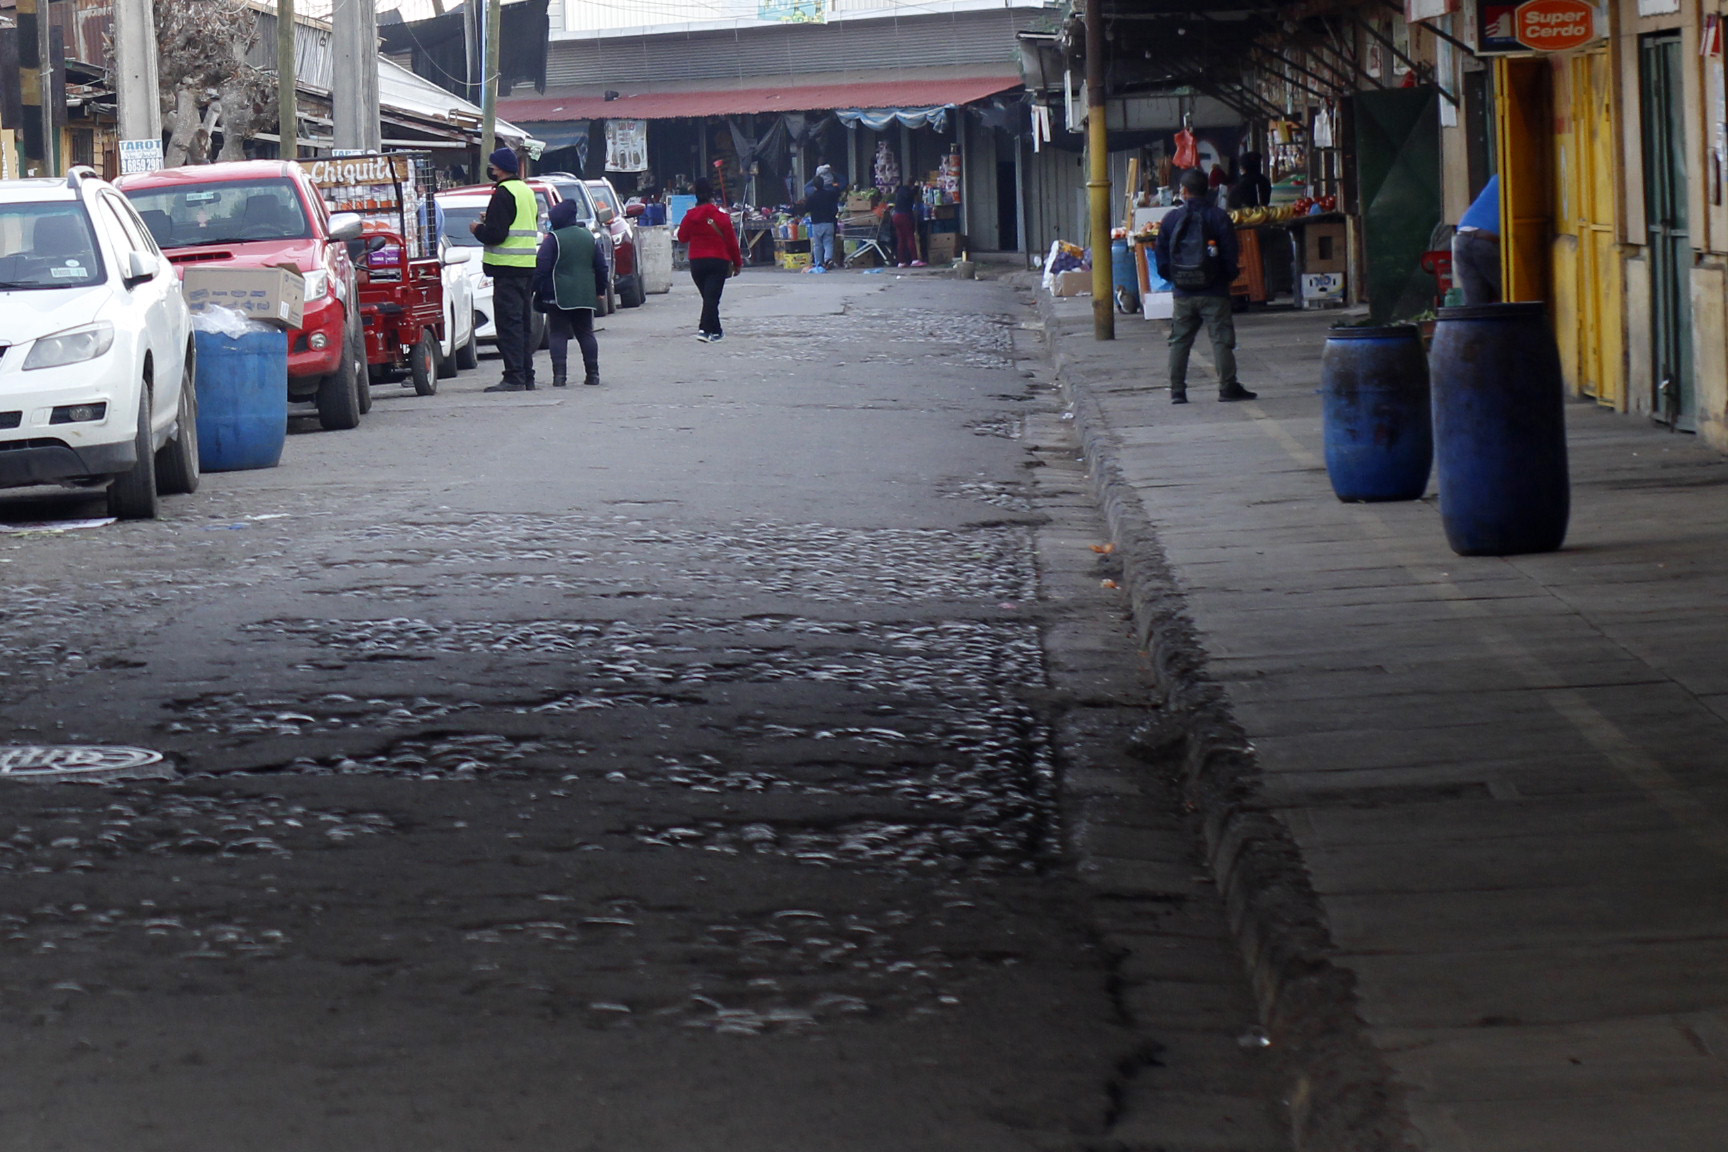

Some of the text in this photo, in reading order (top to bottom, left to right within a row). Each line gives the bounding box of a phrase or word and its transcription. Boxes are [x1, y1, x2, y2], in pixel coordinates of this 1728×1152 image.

[1524, 11, 1586, 25] Super
[1525, 24, 1586, 38] Cerdo
[119, 140, 161, 151] TAROT
[127, 159, 146, 172] 6859
[311, 158, 400, 185] Chiquita
